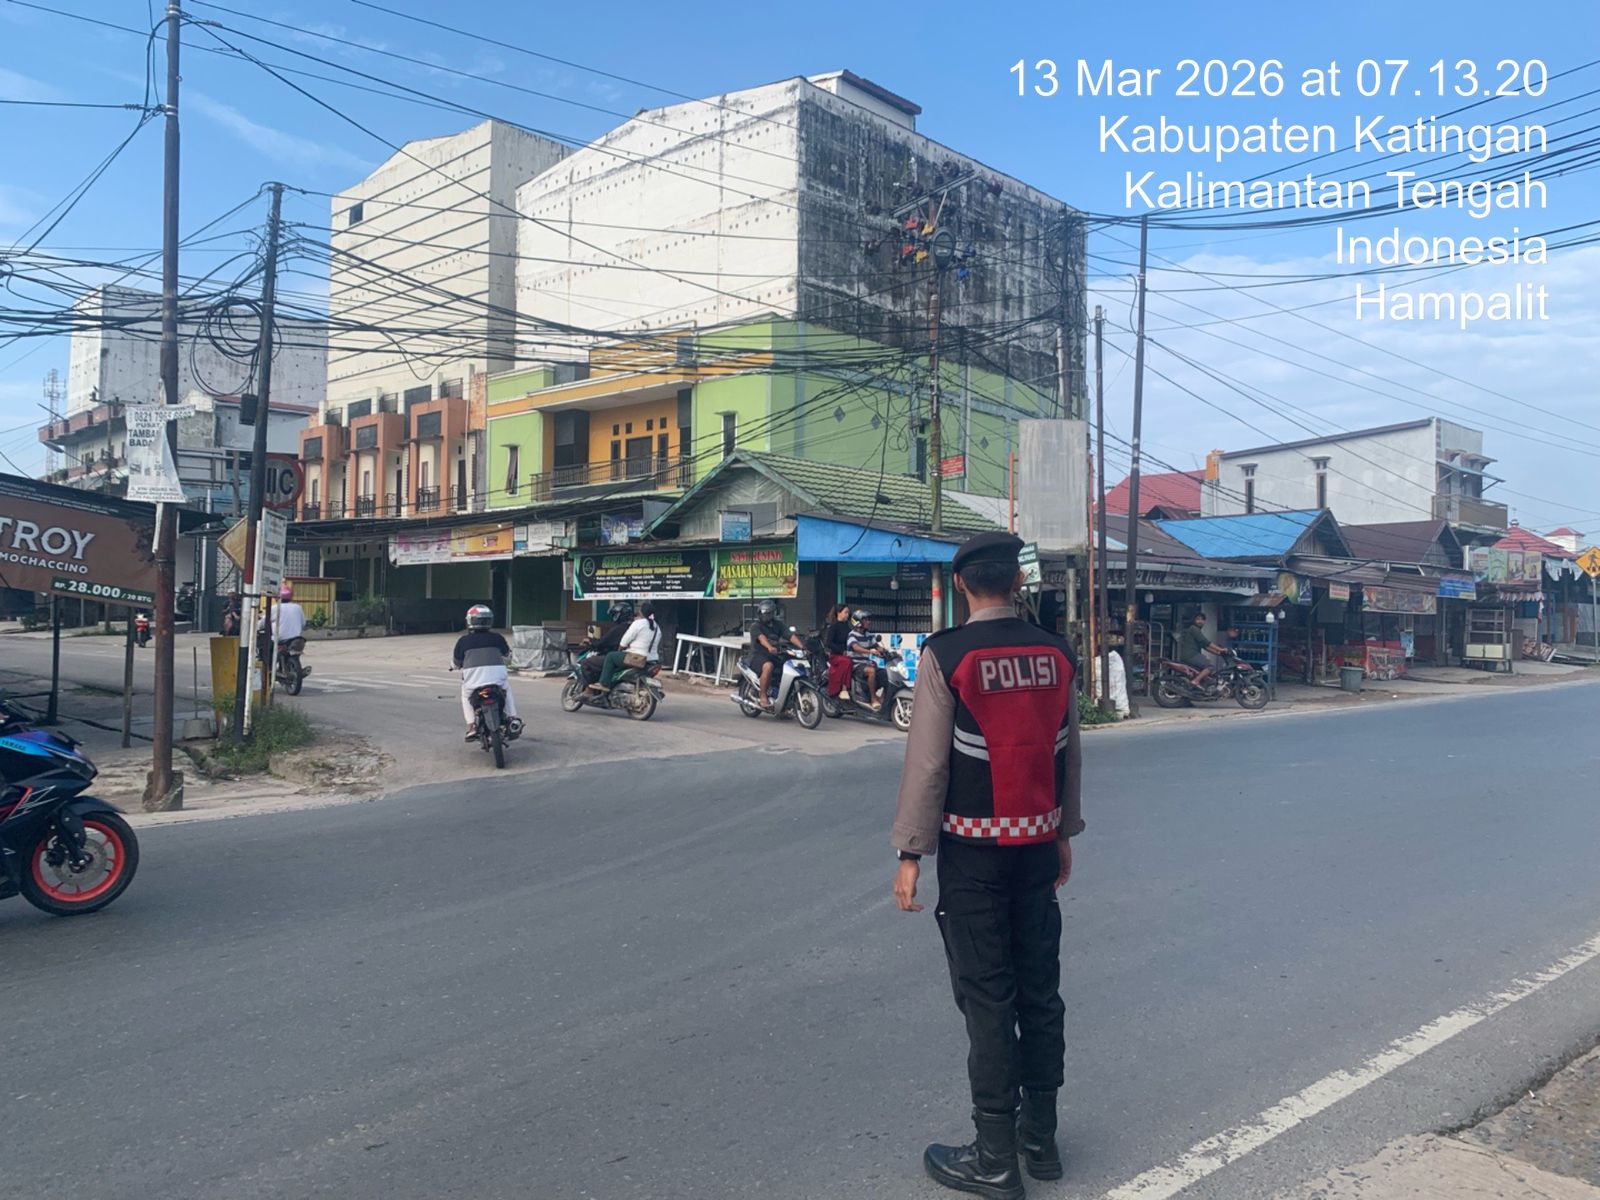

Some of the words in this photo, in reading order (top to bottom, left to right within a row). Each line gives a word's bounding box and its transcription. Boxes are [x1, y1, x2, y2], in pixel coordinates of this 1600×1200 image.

[0, 552, 89, 574] MOCHACCINO
[720, 564, 758, 579] MASAKAN
[760, 562, 794, 578] BANJAR
[68, 580, 121, 598] 28.000
[137, 595, 153, 603] BTG
[980, 655, 1057, 690] POLISI
